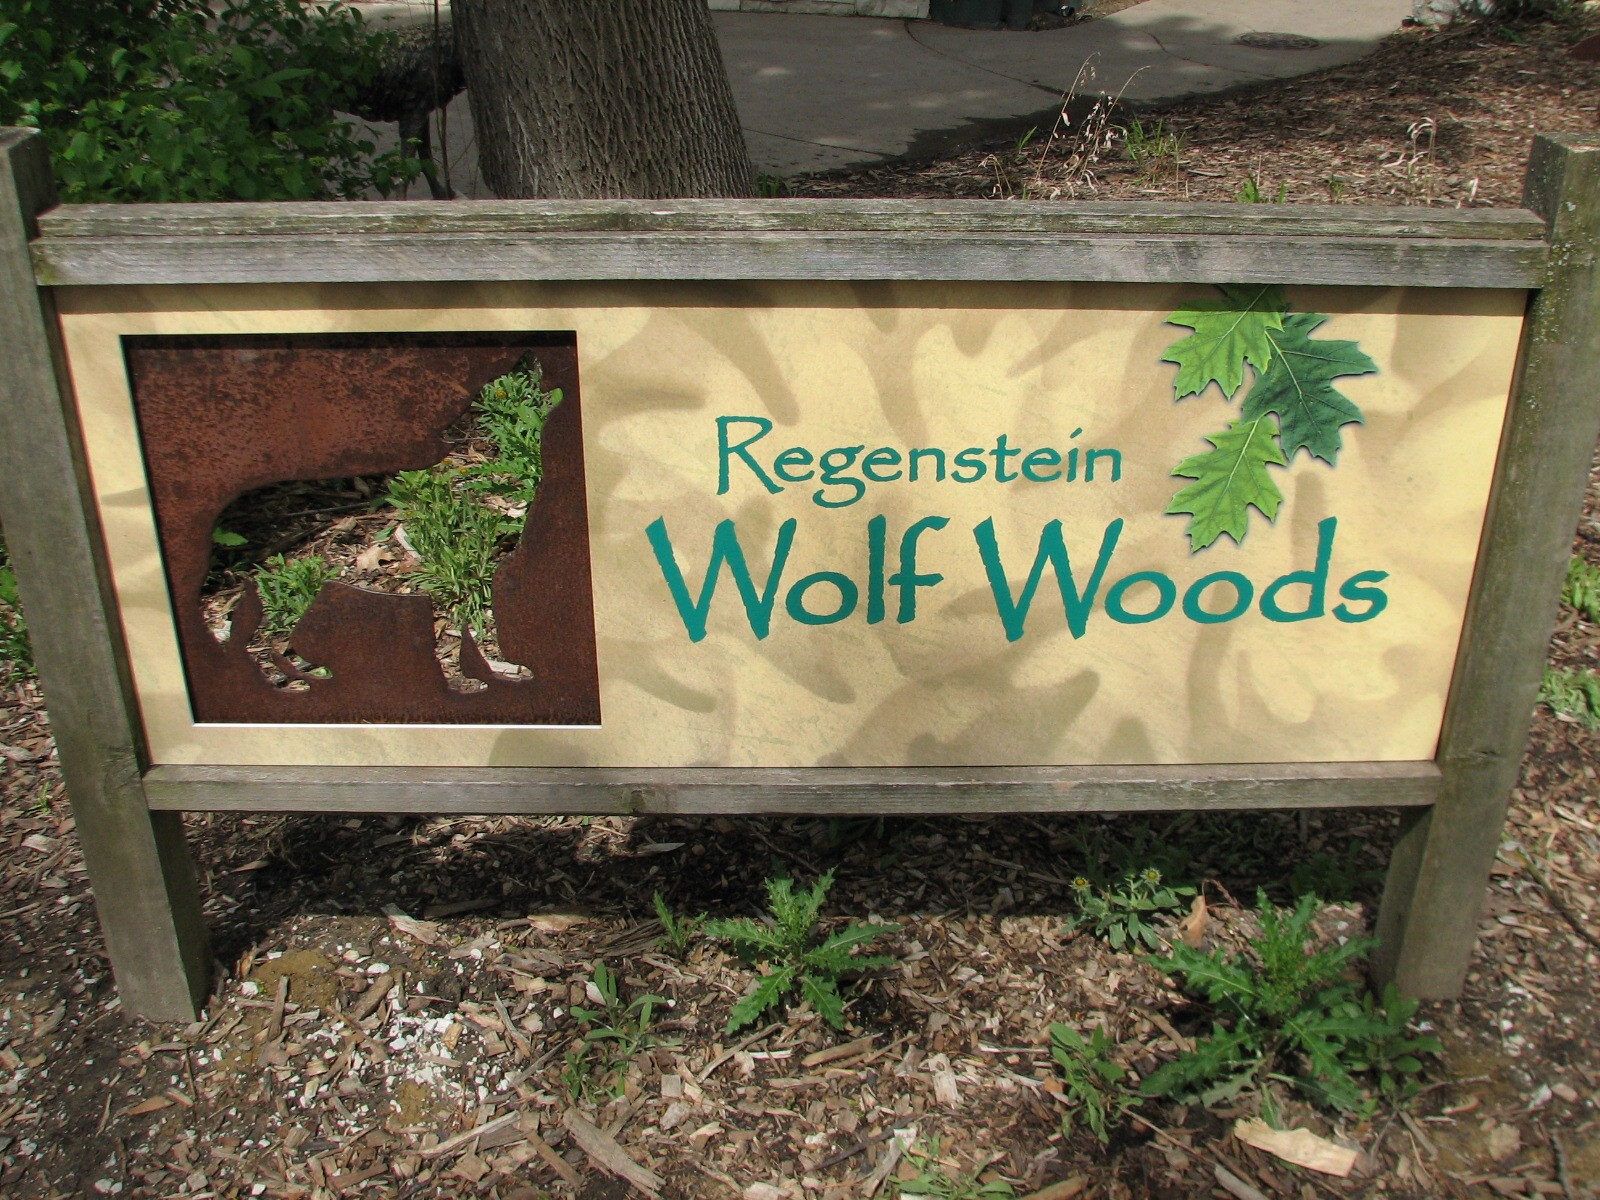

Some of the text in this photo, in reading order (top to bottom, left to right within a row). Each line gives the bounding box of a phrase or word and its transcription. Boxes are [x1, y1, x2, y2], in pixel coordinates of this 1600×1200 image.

[716, 416, 1122, 508] Regenstein
[645, 515, 1389, 643] Wolf Woods
